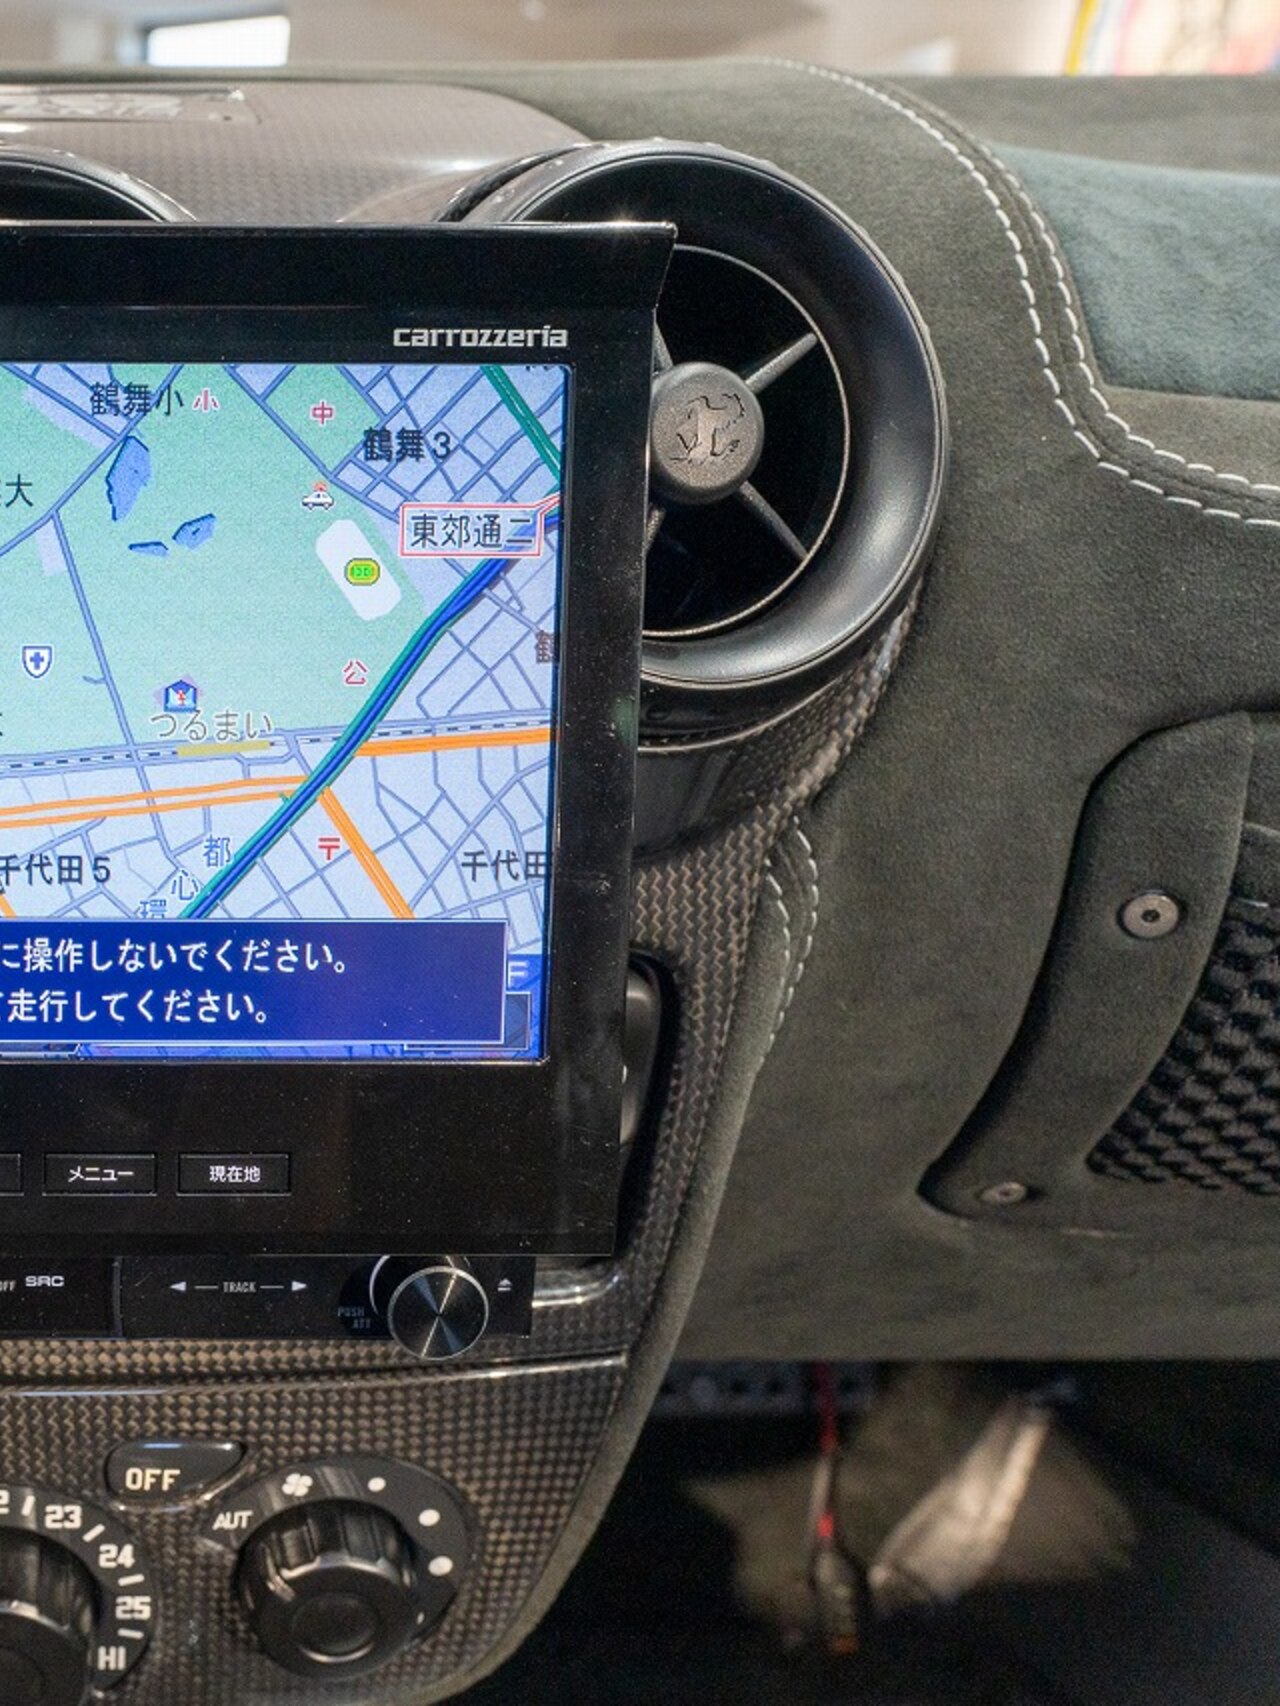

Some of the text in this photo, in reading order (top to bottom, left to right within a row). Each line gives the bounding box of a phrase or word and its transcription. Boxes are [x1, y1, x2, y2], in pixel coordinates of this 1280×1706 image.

[393, 325, 569, 347] carrozzeria
[90, 382, 184, 417] 鶴舞小
[364, 426, 452, 462] 鶴舞3
[411, 513, 533, 548] 東郊通二
[151, 709, 271, 741] つるまい
[68, 1165, 134, 1183] メニュー
[209, 1165, 261, 1183] 現在地
[25, 1275, 65, 1287] SRC
[223, 1281, 257, 1293] TRACK
[125, 1467, 181, 1491] OFF
[44, 1505, 82, 1529] 23
[212, 1509, 253, 1530] AUT
[99, 1544, 135, 1568] 24
[115, 1596, 151, 1619] 25
[97, 1646, 126, 1670] HI
